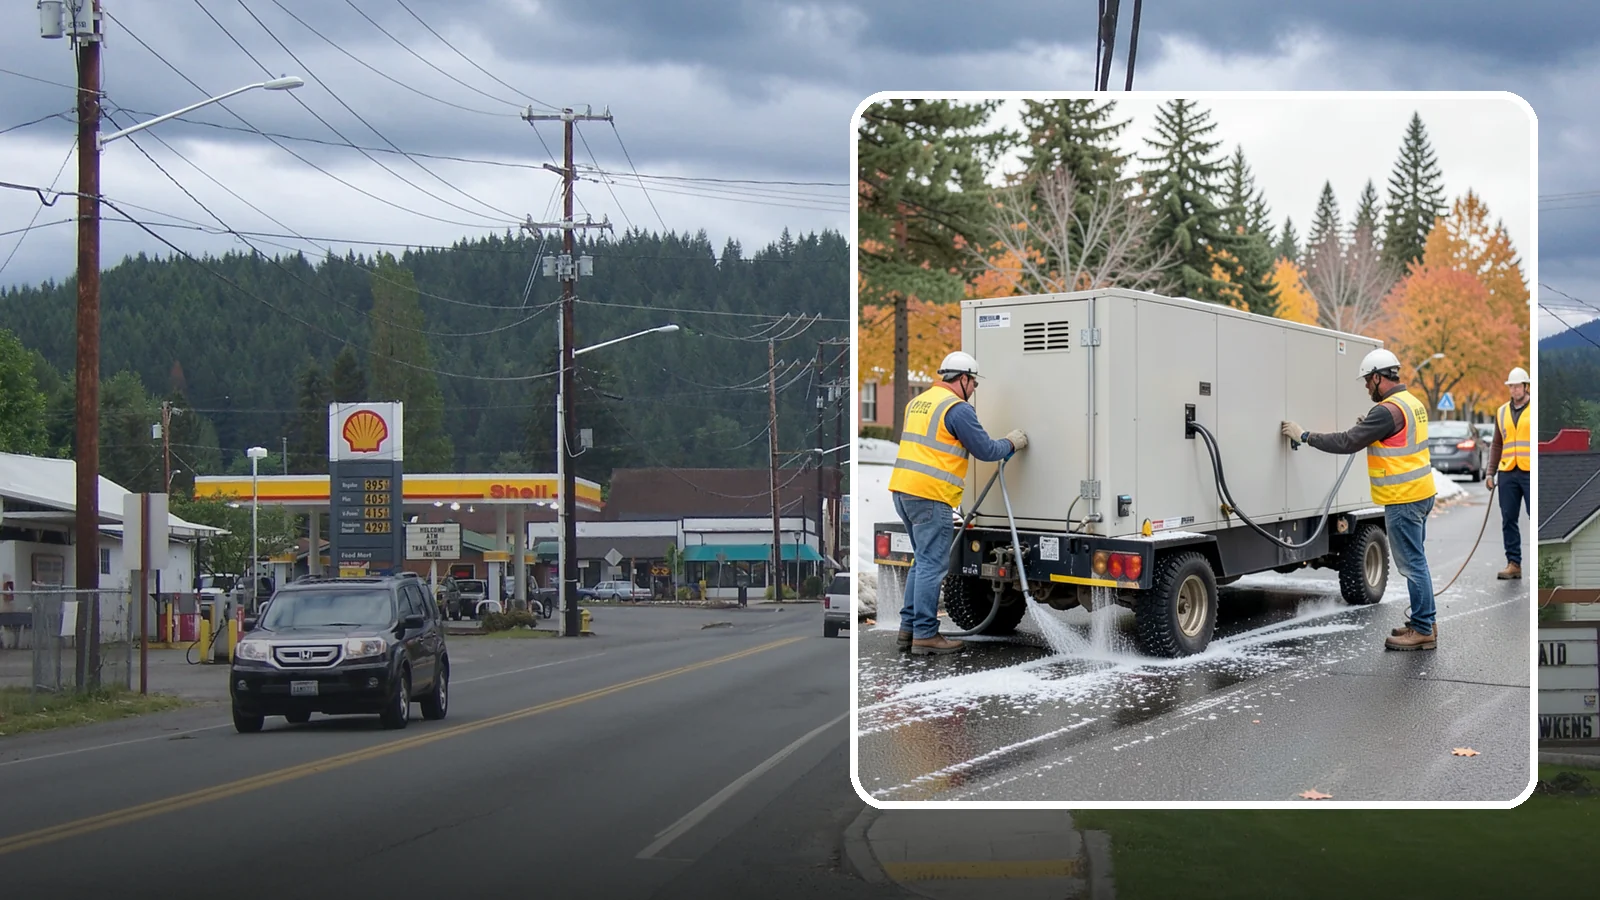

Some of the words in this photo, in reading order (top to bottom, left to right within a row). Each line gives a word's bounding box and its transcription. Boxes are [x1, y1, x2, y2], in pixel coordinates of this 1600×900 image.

[366, 479, 384, 490] 395
[490, 484, 547, 499] Shell
[366, 494, 384, 504] 405
[366, 508, 384, 518] 415
[366, 522, 384, 533] 429
